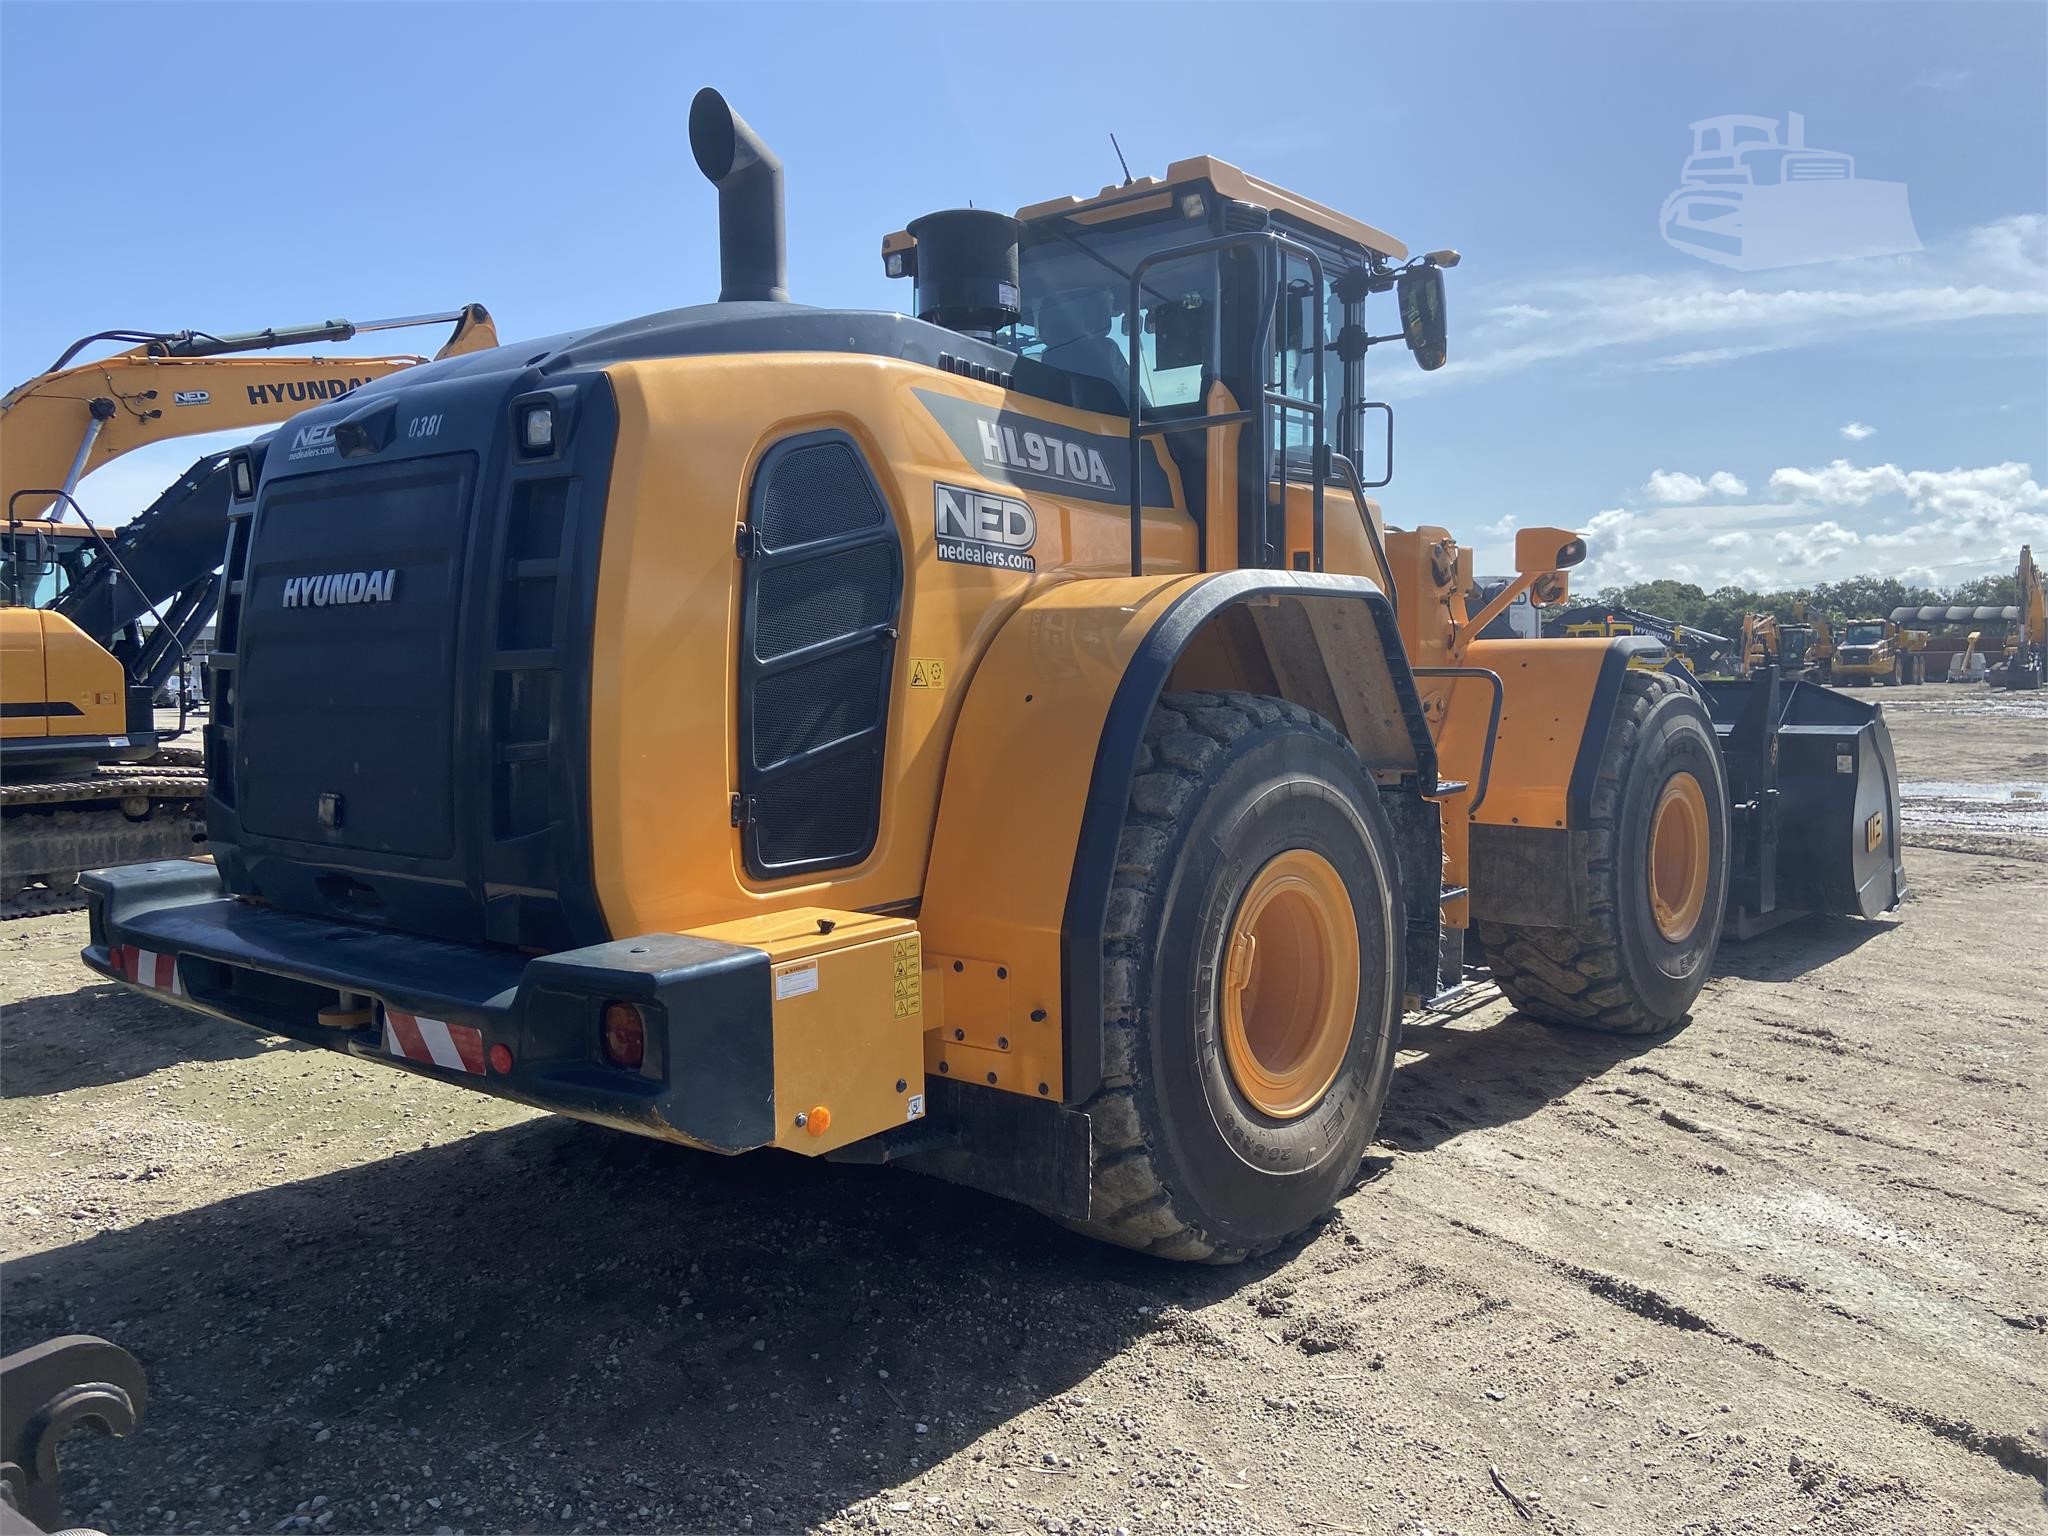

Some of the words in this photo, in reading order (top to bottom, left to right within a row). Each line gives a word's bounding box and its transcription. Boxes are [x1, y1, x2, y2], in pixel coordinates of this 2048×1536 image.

[175, 391, 209, 402] NED
[977, 419, 1112, 486] HL970A
[938, 488, 1035, 546] NED
[938, 542, 1035, 570] nedealers.com
[282, 569, 396, 607] HYUNDAI
[1634, 626, 1672, 641] HYUNDAI
